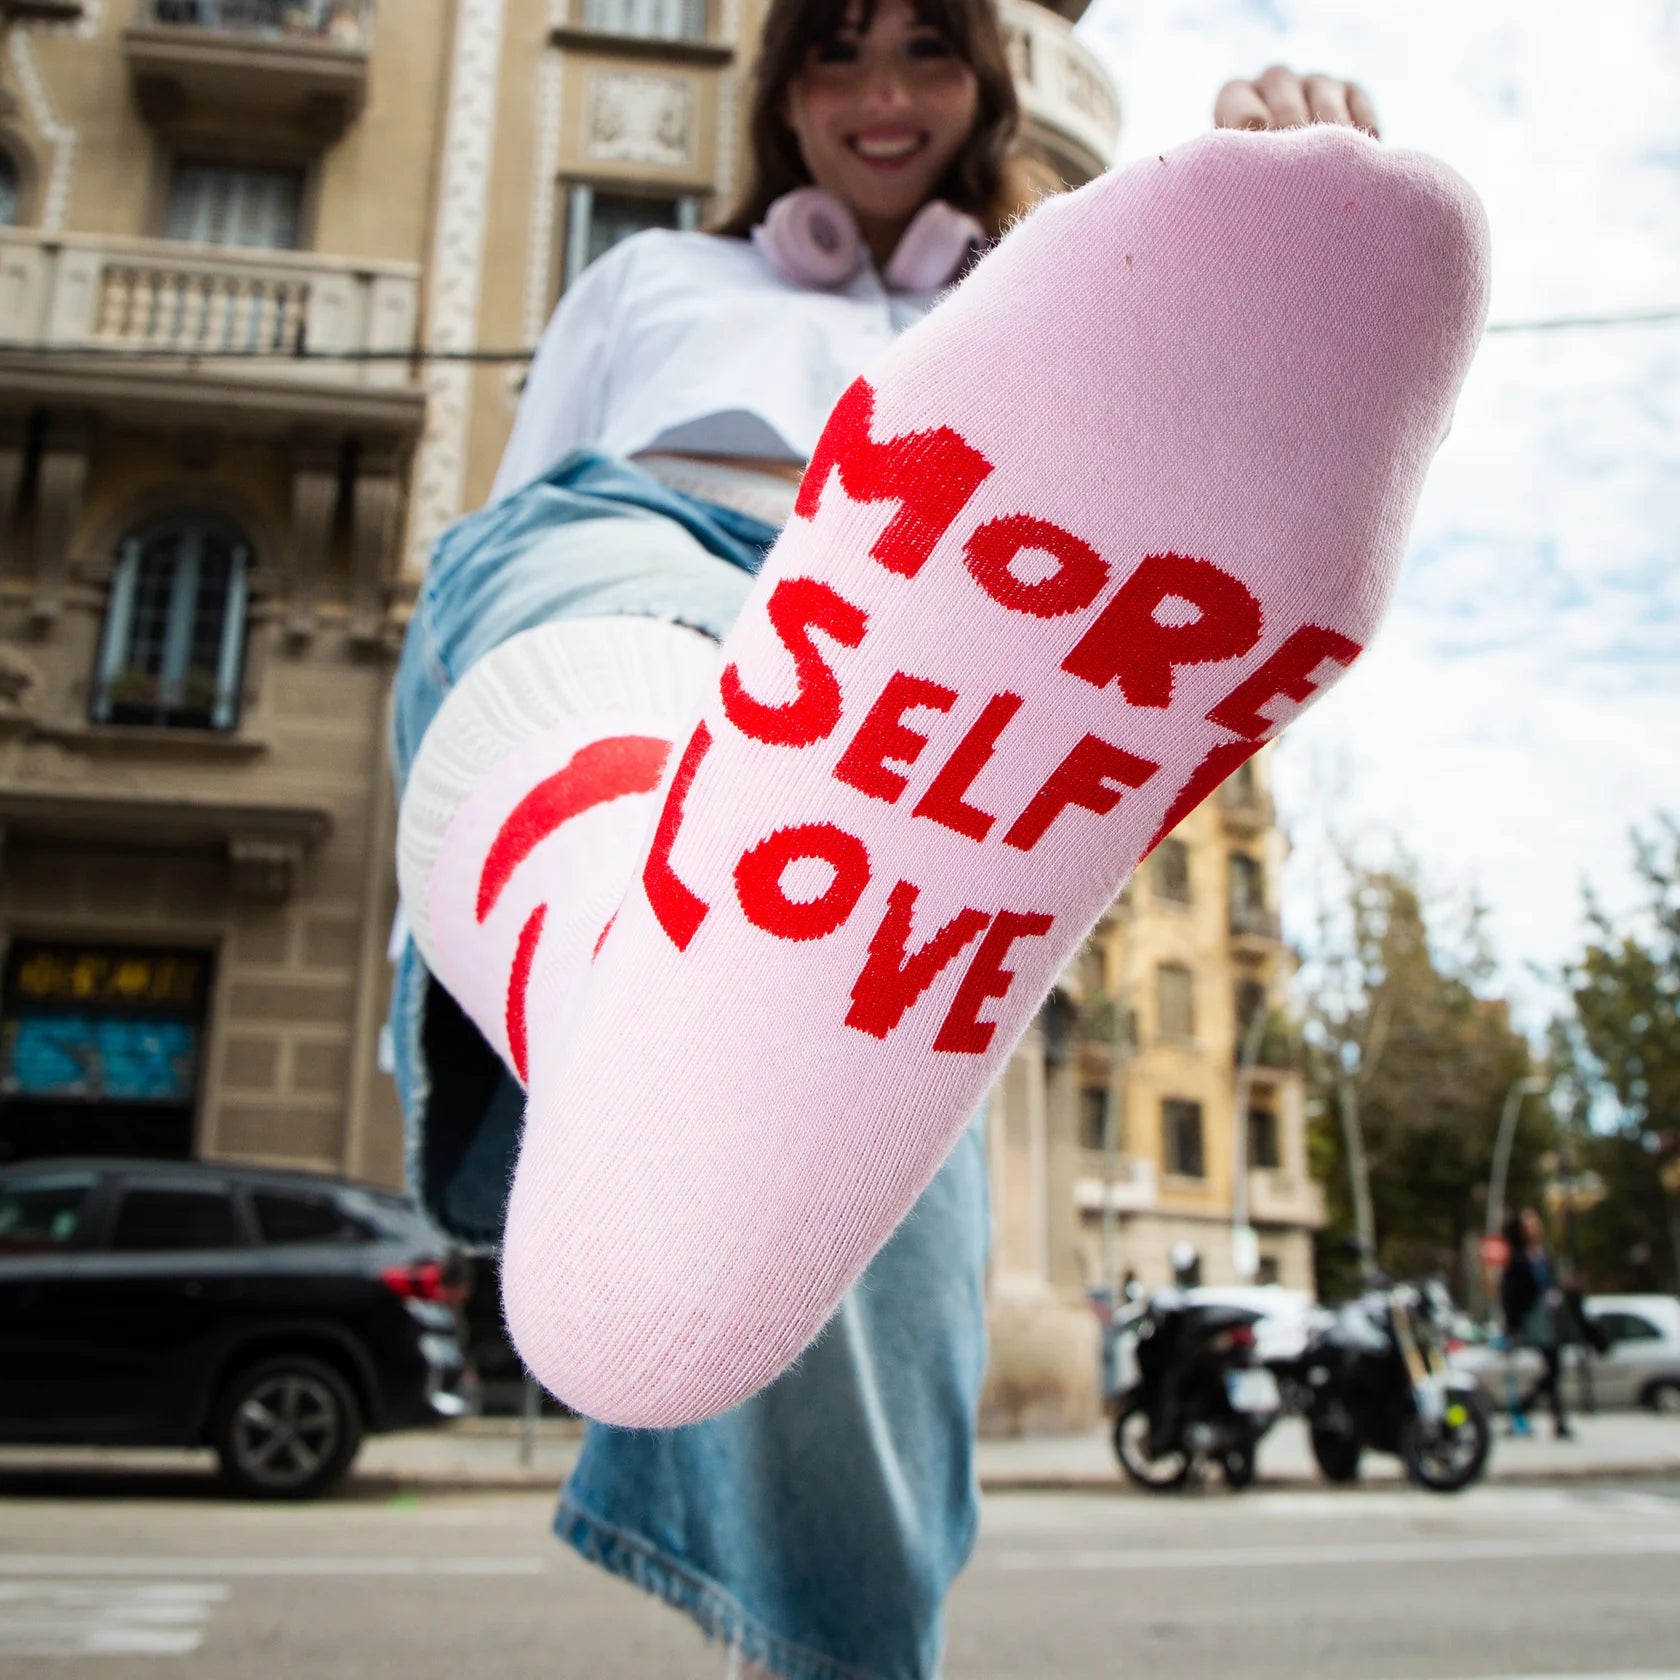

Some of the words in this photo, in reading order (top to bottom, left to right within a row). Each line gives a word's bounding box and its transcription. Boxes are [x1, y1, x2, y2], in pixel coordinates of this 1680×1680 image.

[720, 576, 1161, 852] SELF
[795, 376, 1363, 741] MORE
[642, 719, 1055, 1055] LOVE
